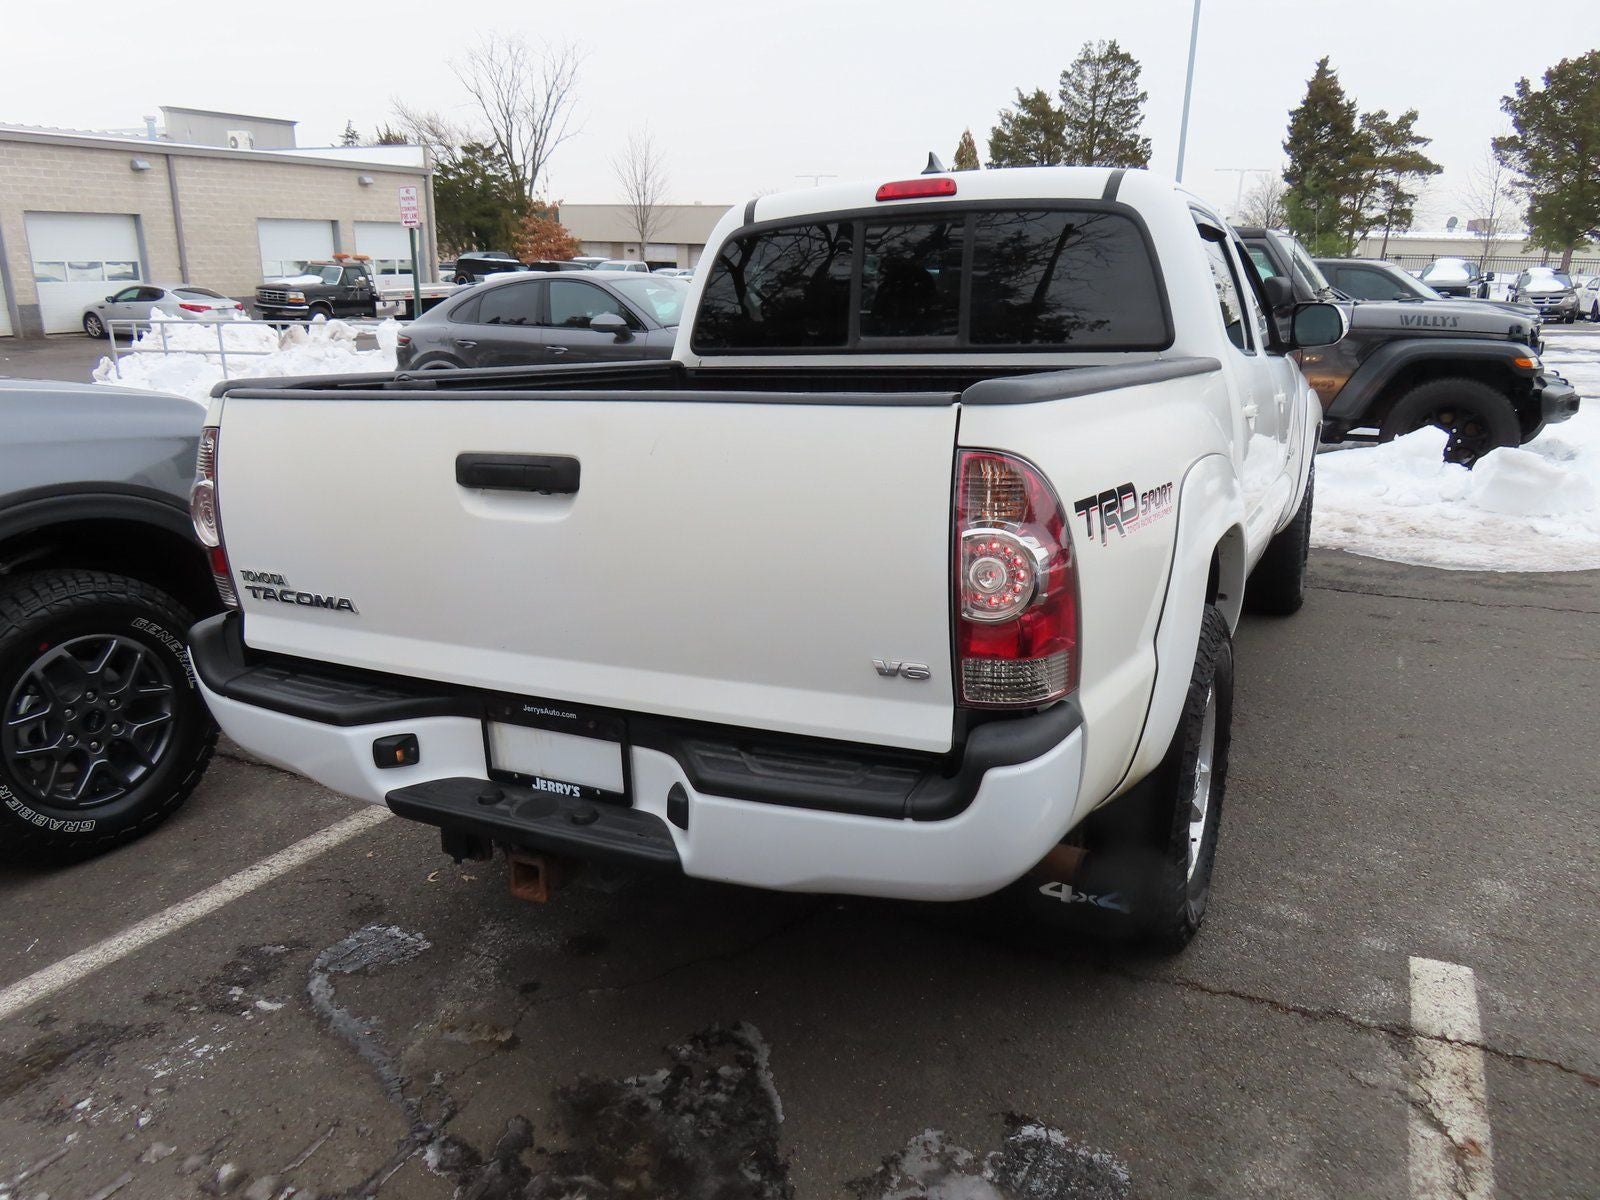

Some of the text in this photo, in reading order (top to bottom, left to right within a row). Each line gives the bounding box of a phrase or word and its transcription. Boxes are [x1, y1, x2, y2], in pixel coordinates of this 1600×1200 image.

[1399, 314, 1460, 328] WILLYS
[1074, 481, 1173, 548] TRD SPORT
[240, 569, 289, 587] TOYOTA
[245, 585, 360, 615] TACOMA
[131, 617, 197, 689] GENERAL
[872, 659, 931, 681] V6
[523, 704, 577, 720] JerrysAuto.com
[532, 777, 581, 798] JERRY'S
[0, 785, 96, 833] GRABBER
